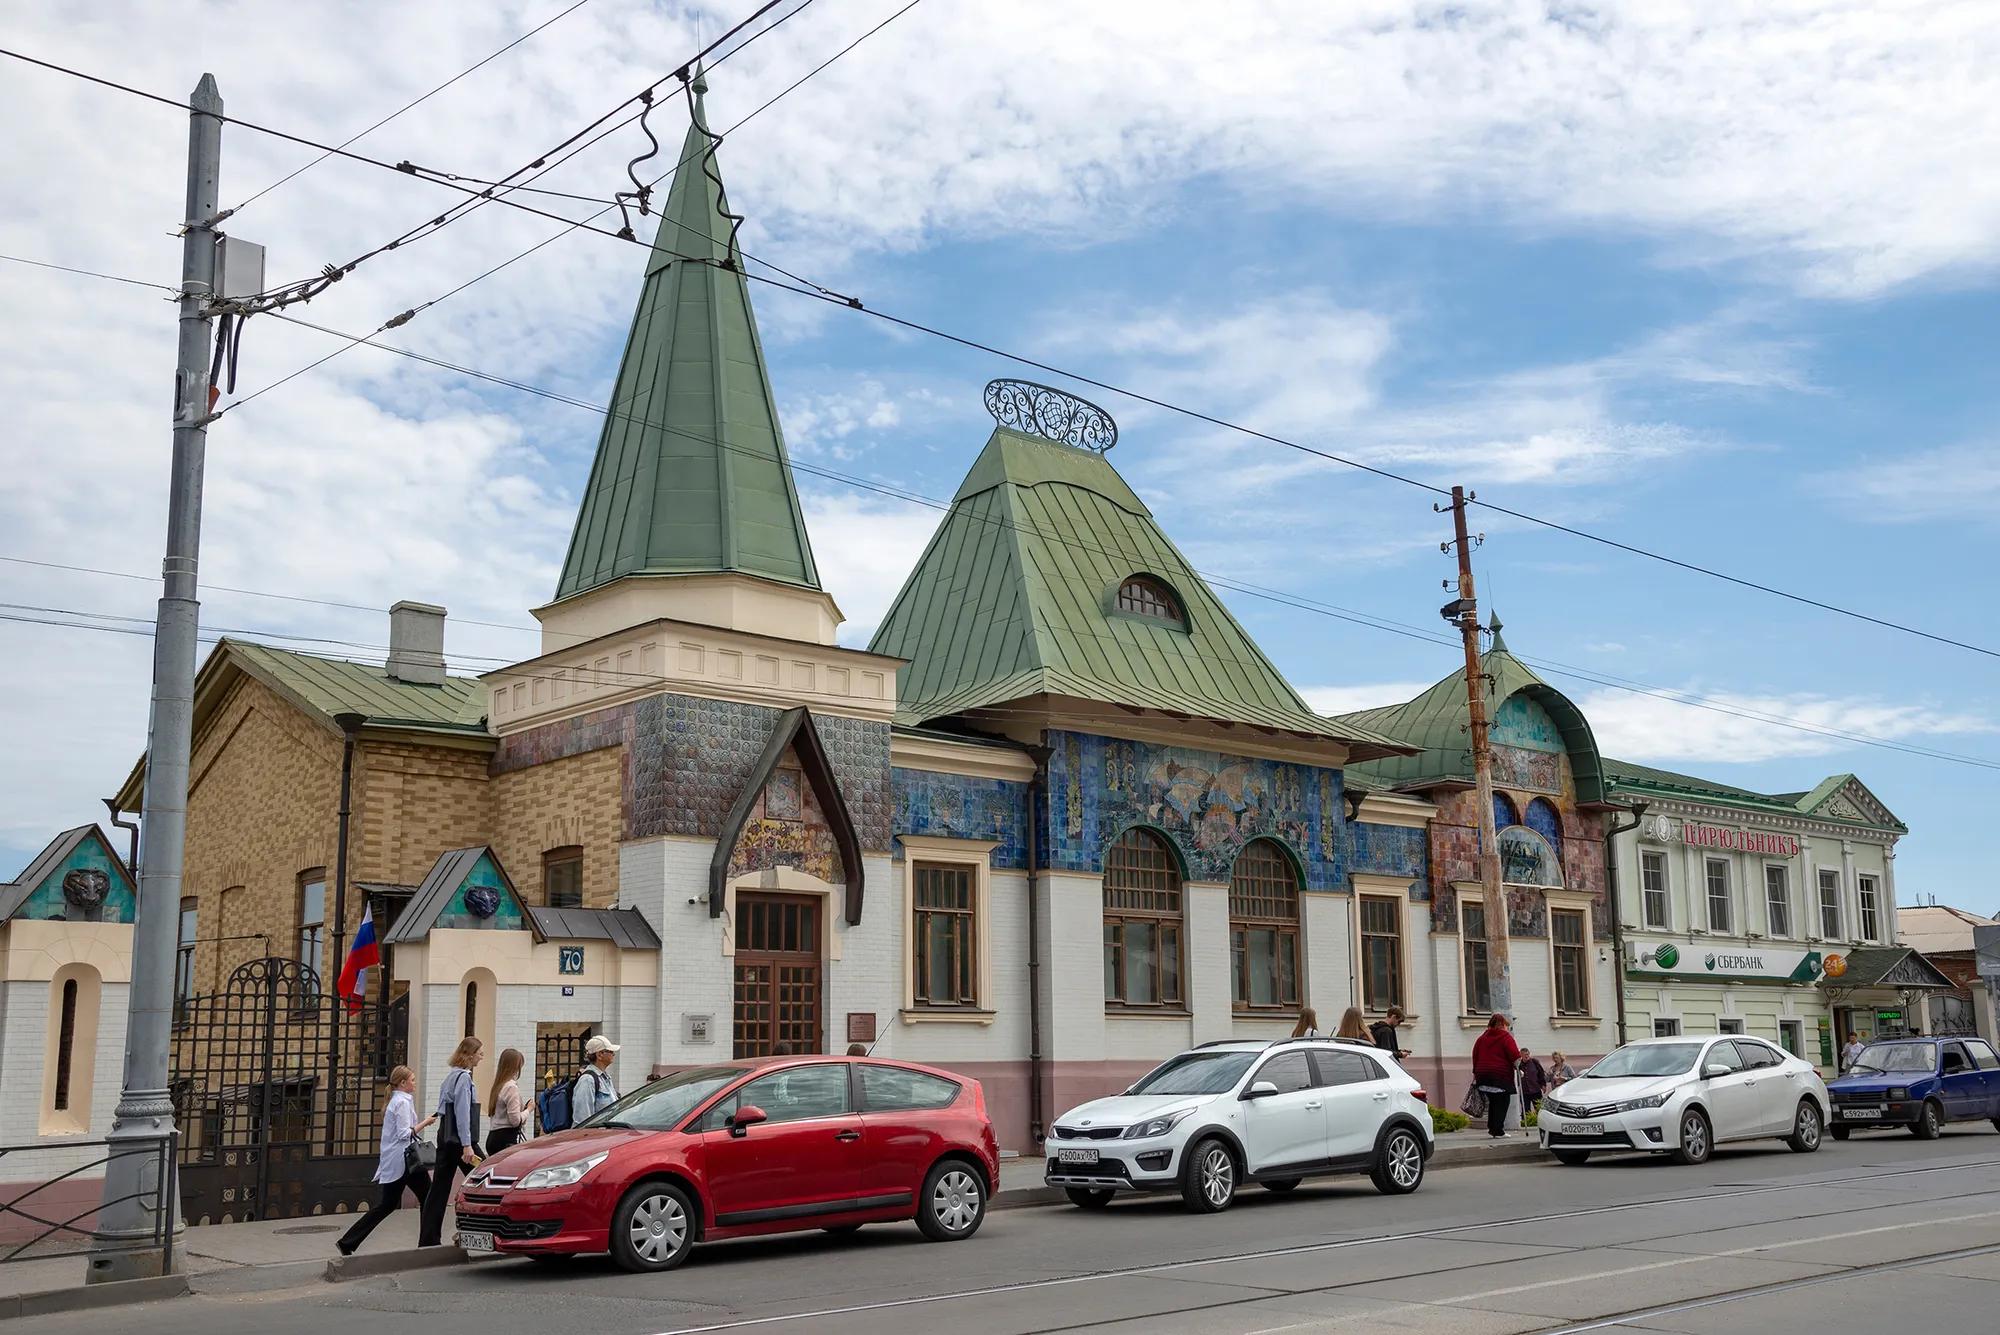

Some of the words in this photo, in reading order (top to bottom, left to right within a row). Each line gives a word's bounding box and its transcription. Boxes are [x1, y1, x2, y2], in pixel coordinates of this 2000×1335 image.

[1684, 823, 1799, 856] ЦИРЮЛЬНИКЪ
[563, 950, 581, 971] 70
[1717, 954, 1764, 969] СБЕРБАНК
